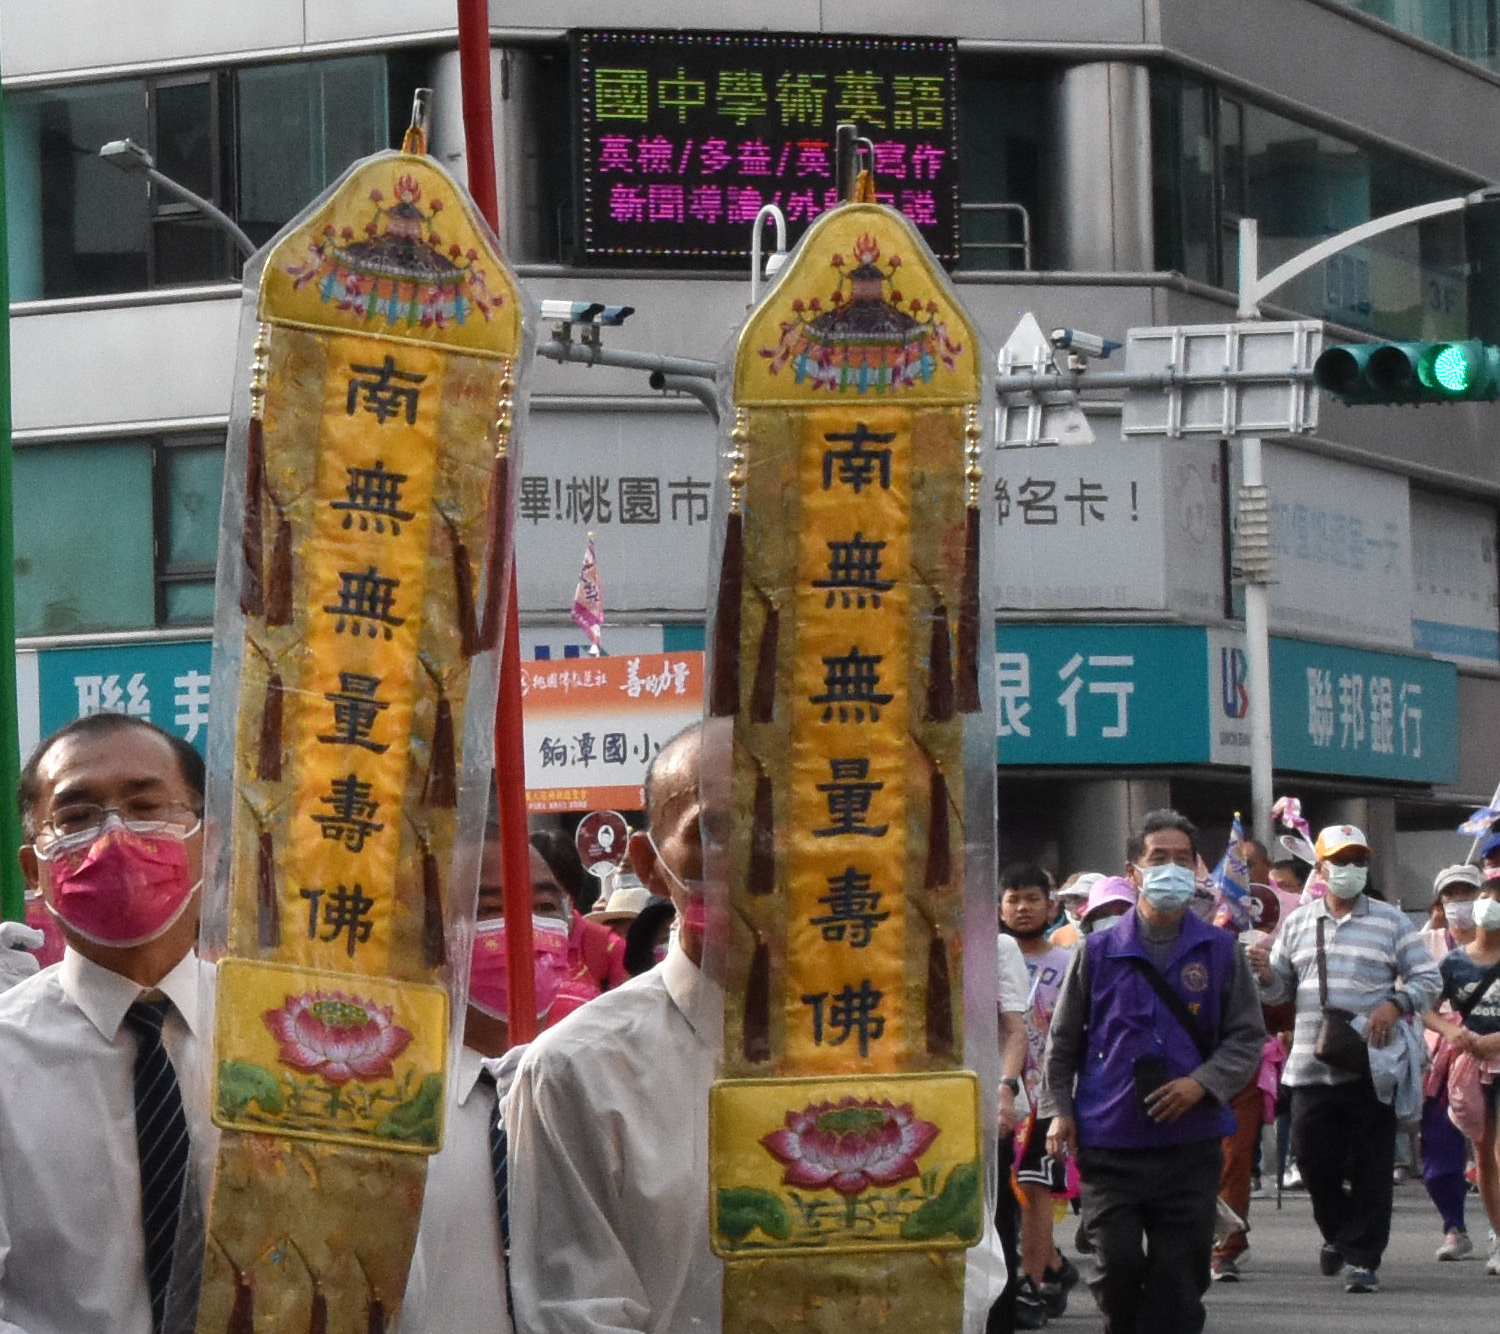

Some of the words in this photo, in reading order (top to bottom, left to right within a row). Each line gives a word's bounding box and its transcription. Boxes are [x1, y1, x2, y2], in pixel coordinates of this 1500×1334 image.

[594, 65, 945, 131] 國中學術英語
[599, 132, 946, 180] 英檢/多益/英寫作
[298, 354, 428, 957] 南無無量壽佛
[801, 421, 898, 1059] 南無無量壽佛
[1306, 666, 1423, 759] 聯邦銀行
